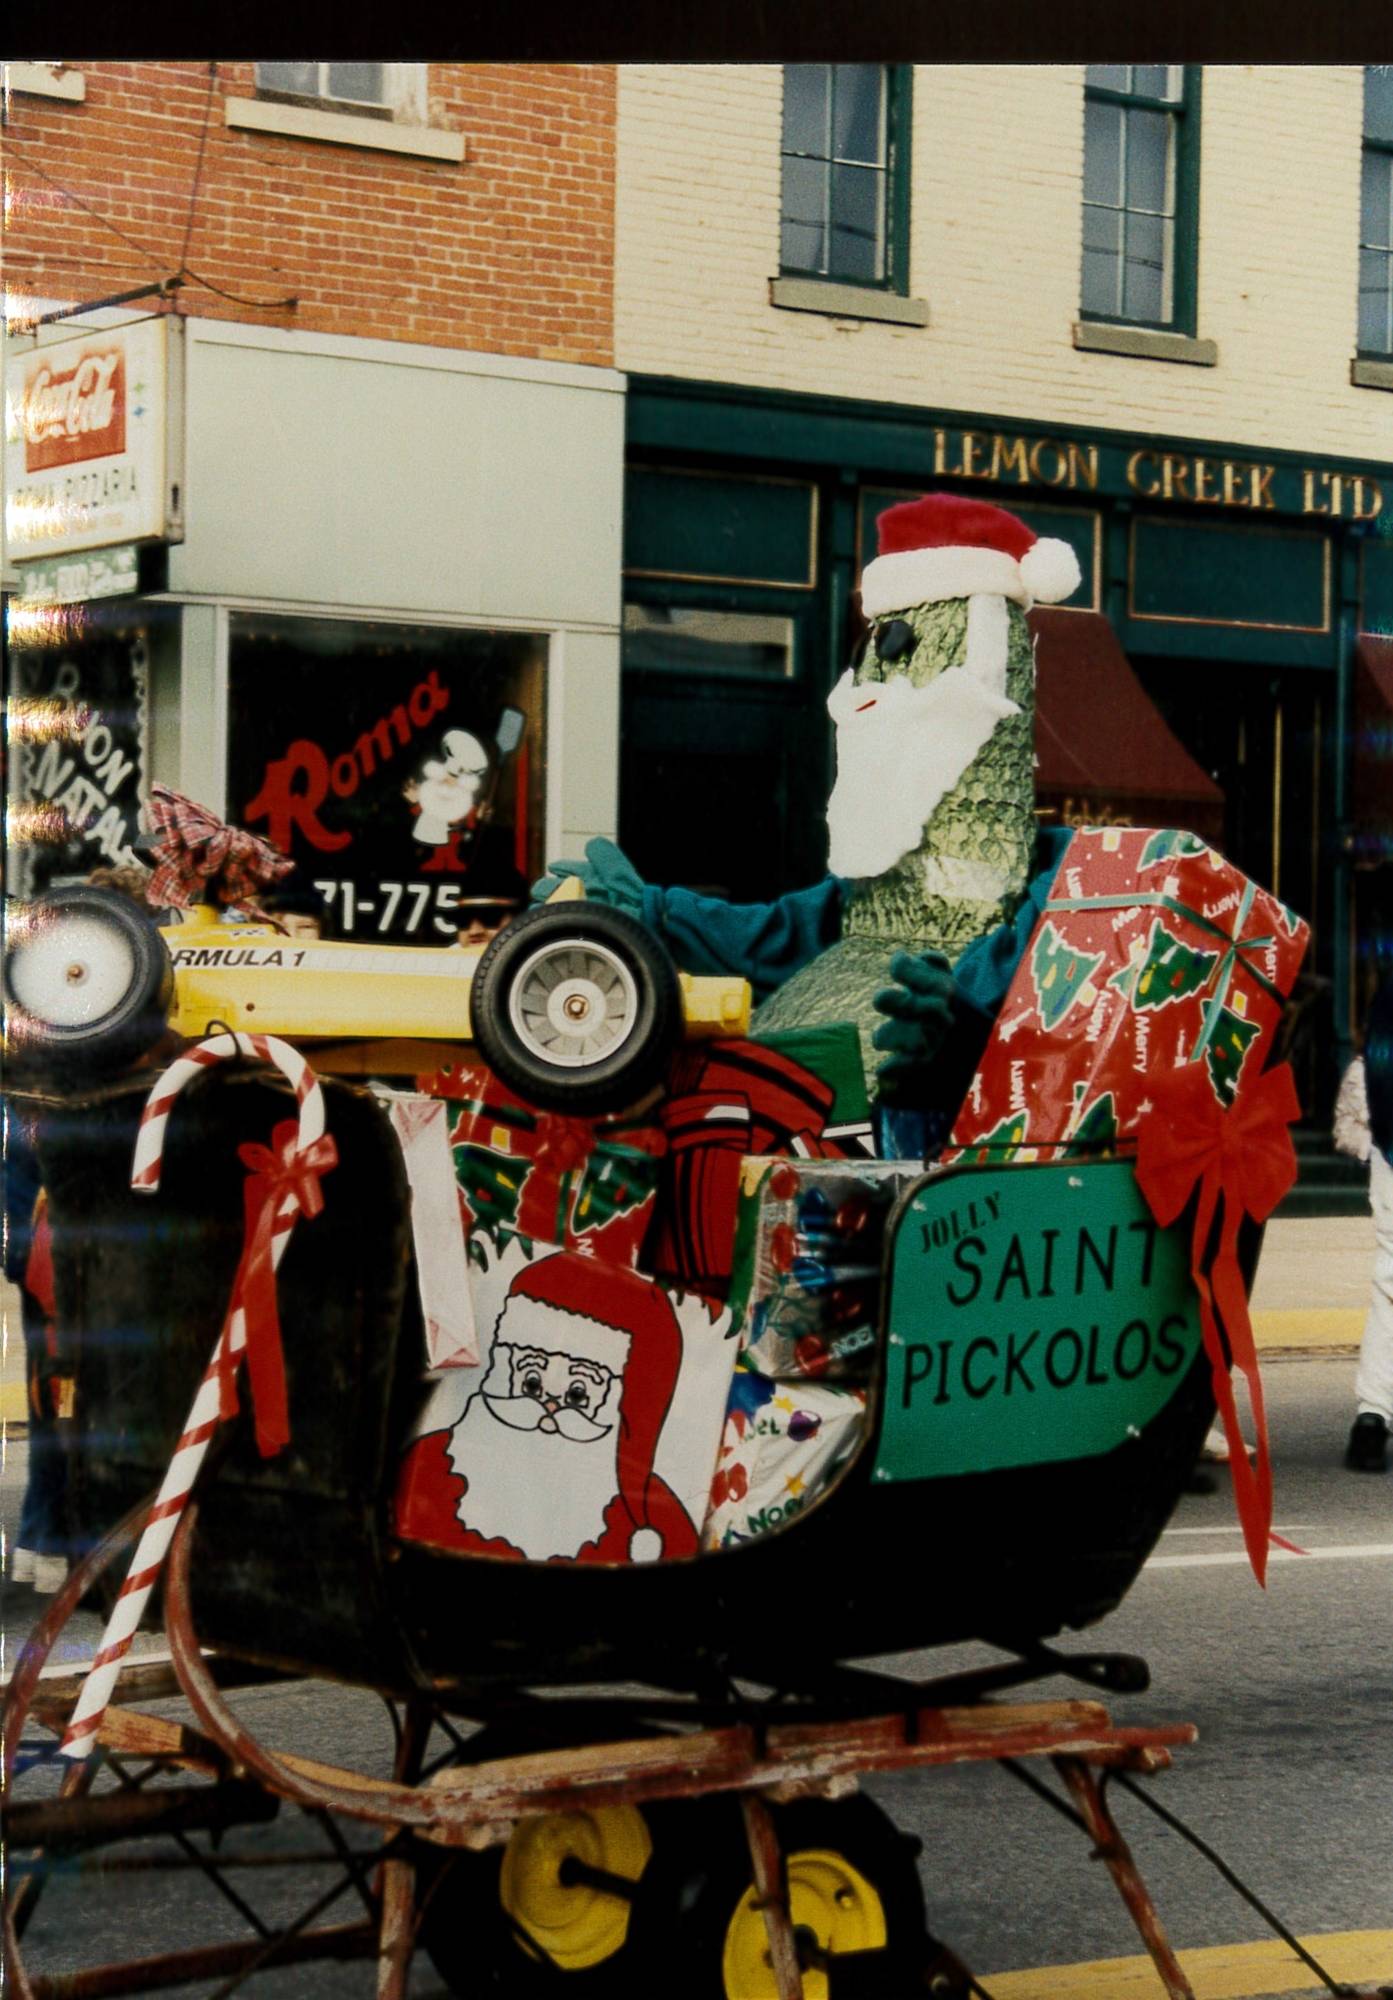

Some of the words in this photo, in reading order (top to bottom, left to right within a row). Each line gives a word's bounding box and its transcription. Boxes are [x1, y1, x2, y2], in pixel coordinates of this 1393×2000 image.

[933, 428, 1099, 489] LEMON
[1127, 449, 1277, 510] CREEK
[1303, 469, 1384, 521] LTD
[244, 669, 450, 855] Roma
[170, 949, 284, 967] RMULA
[292, 950, 307, 968] 1
[1132, 1015, 1151, 1074] Merry
[920, 1191, 1000, 1253] JOLLY
[946, 1221, 1158, 1306] SAINT
[902, 1315, 1188, 1409] PICKOLOS
